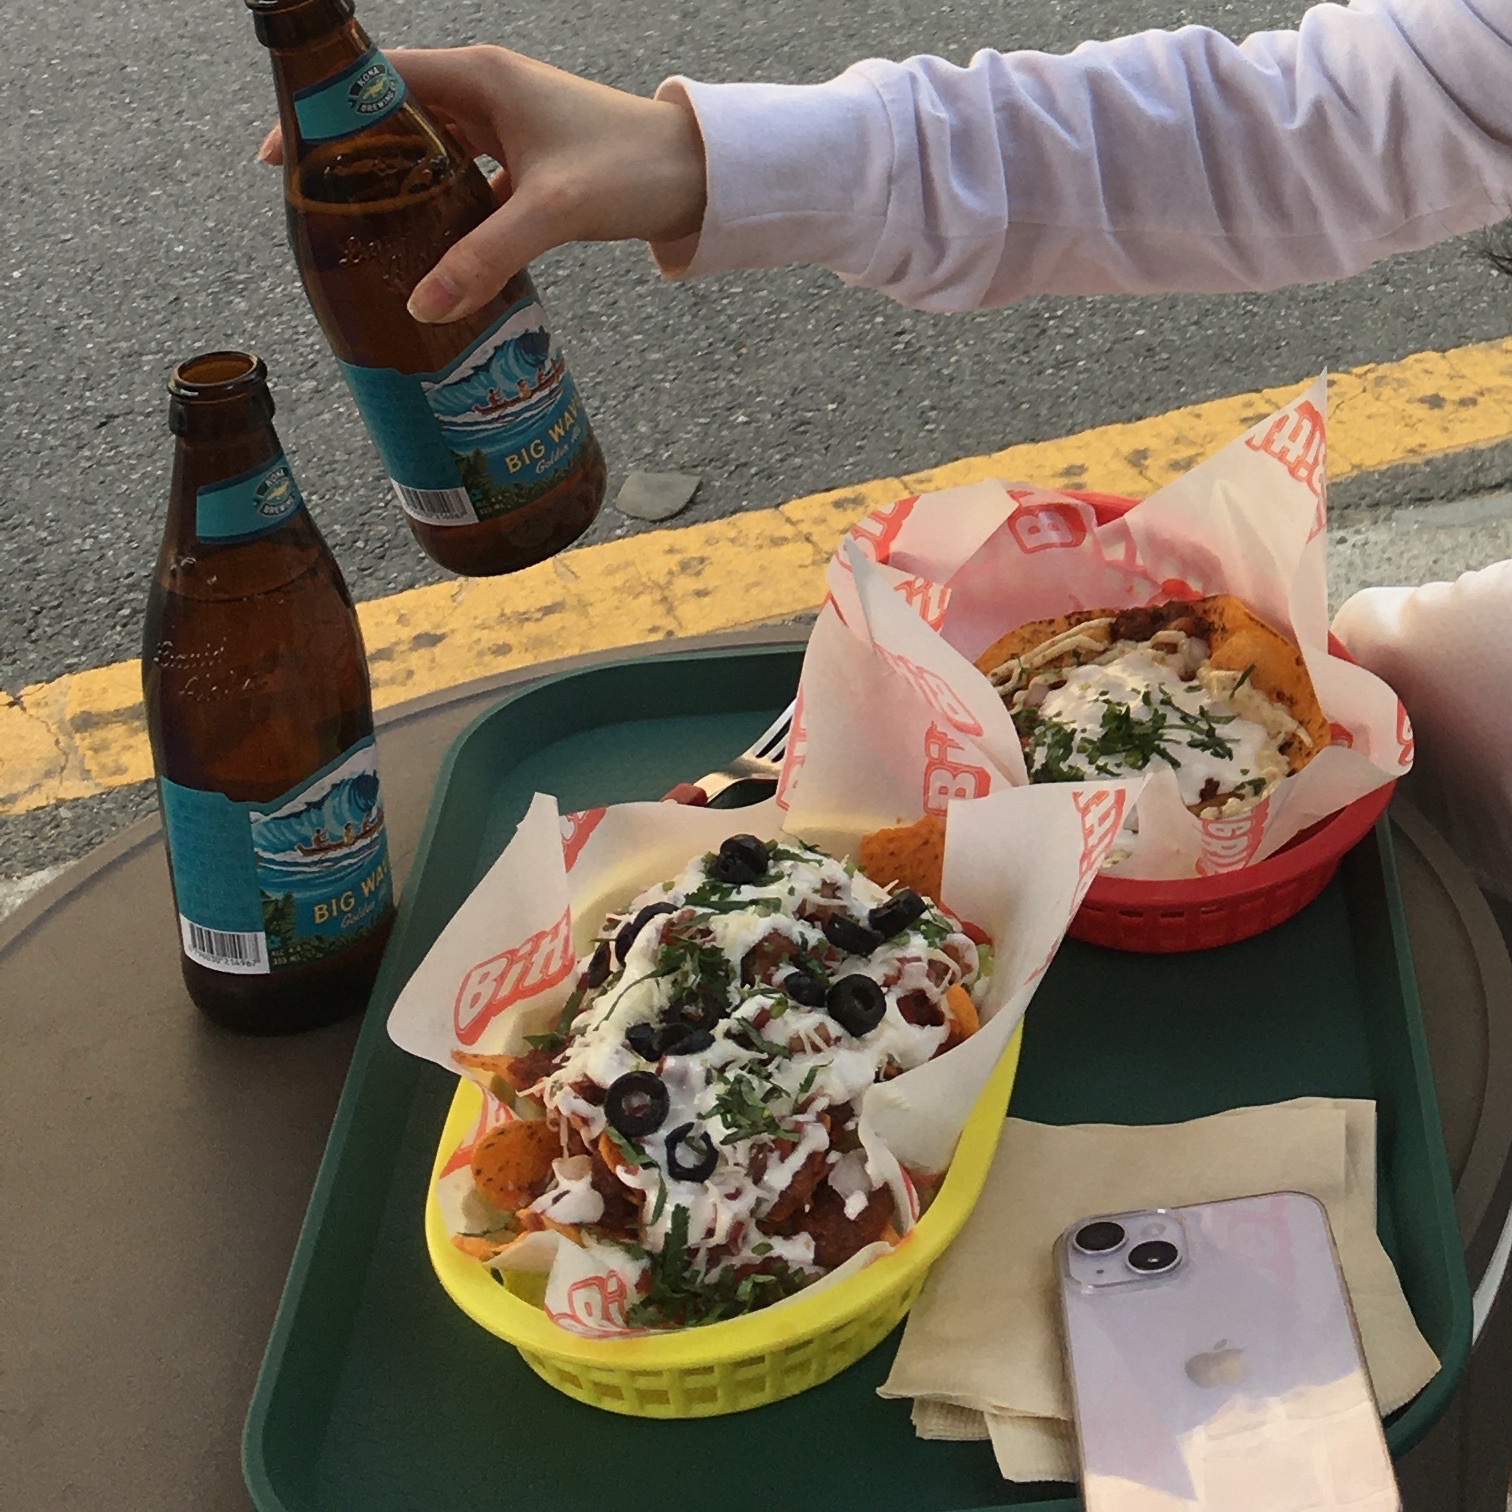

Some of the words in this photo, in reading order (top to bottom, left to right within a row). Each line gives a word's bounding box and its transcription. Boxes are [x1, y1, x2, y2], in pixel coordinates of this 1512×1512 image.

[504, 438, 547, 474] BIG
[547, 394, 581, 443] WAV
[313, 890, 356, 924] BIG
